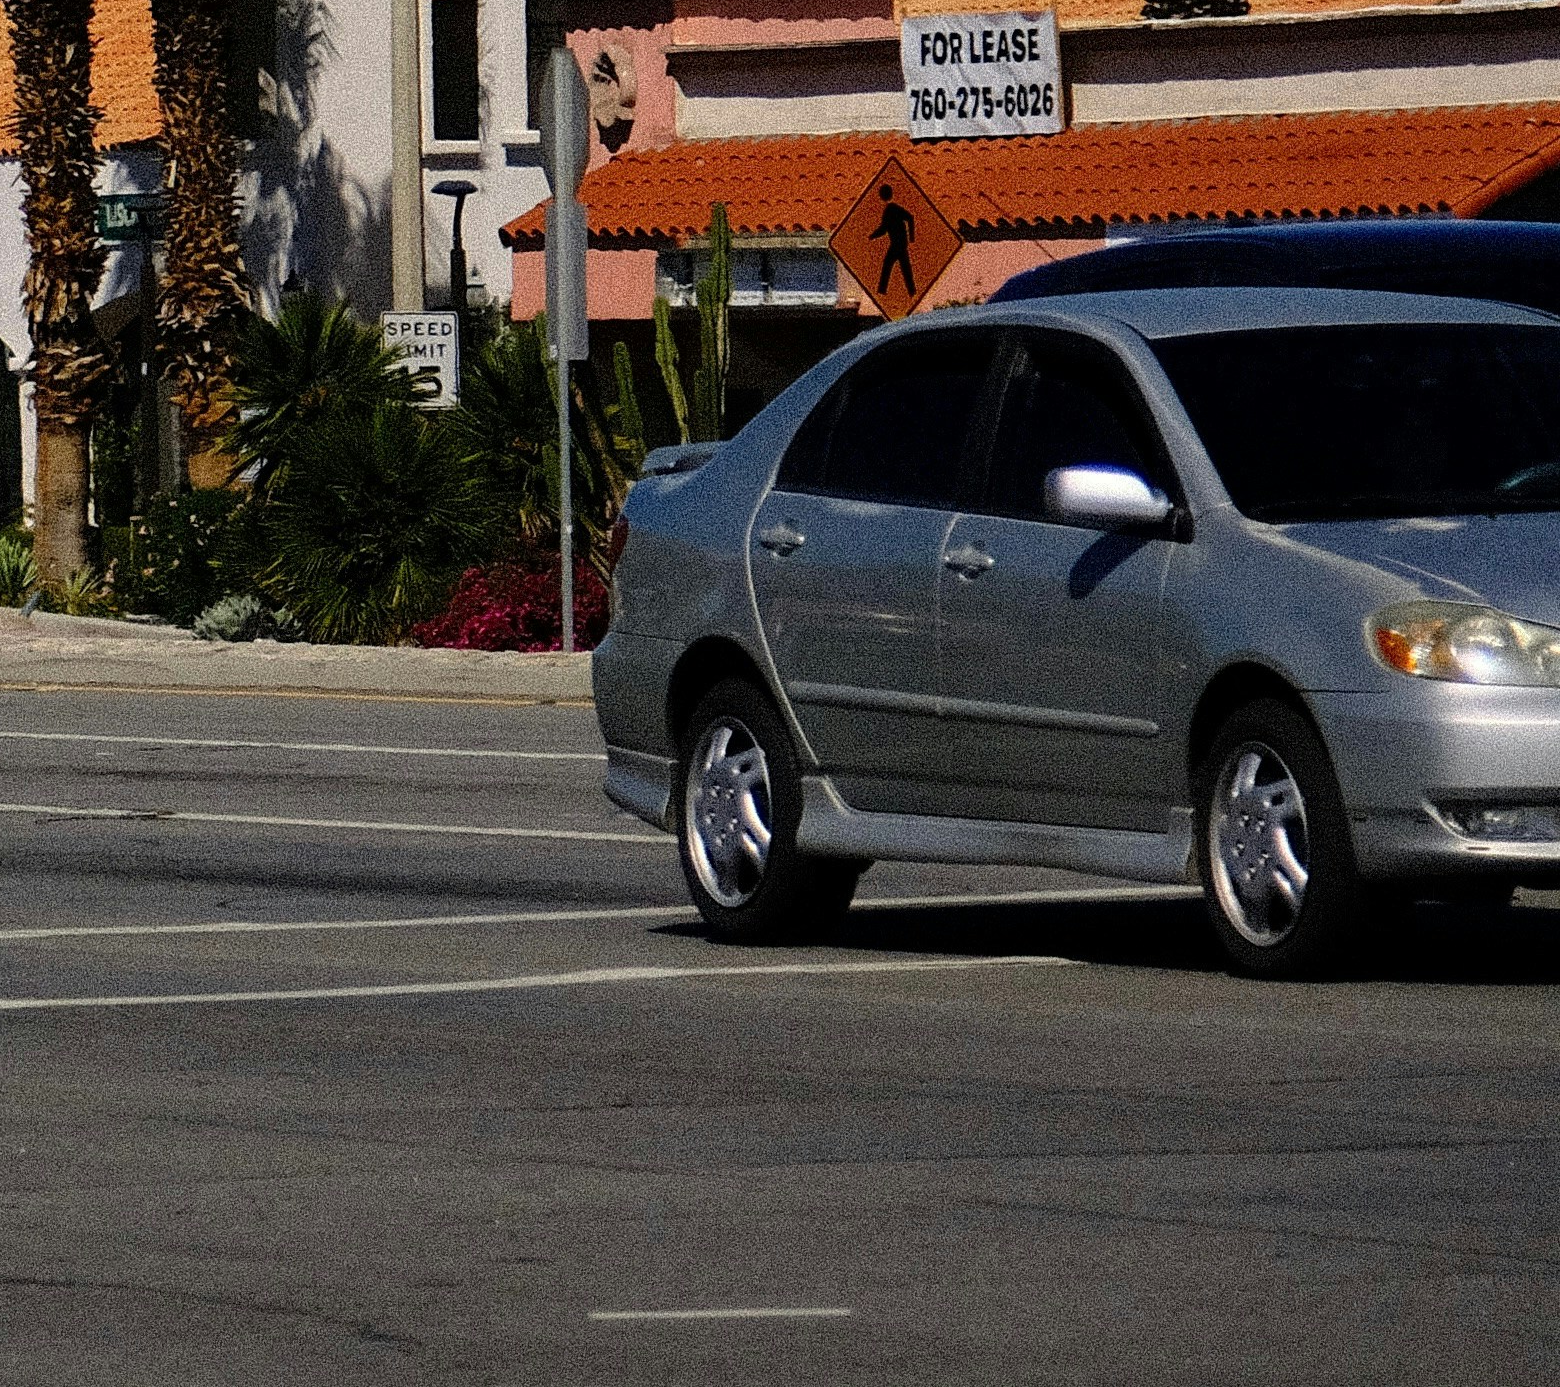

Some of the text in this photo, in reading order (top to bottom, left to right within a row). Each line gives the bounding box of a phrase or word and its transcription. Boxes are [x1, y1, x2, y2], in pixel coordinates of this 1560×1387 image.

[920, 28, 1041, 66] FOR LEASE
[910, 82, 1054, 121] 760-275-6026
[386, 321, 453, 336] SPEED
[404, 344, 447, 359] IMIT
